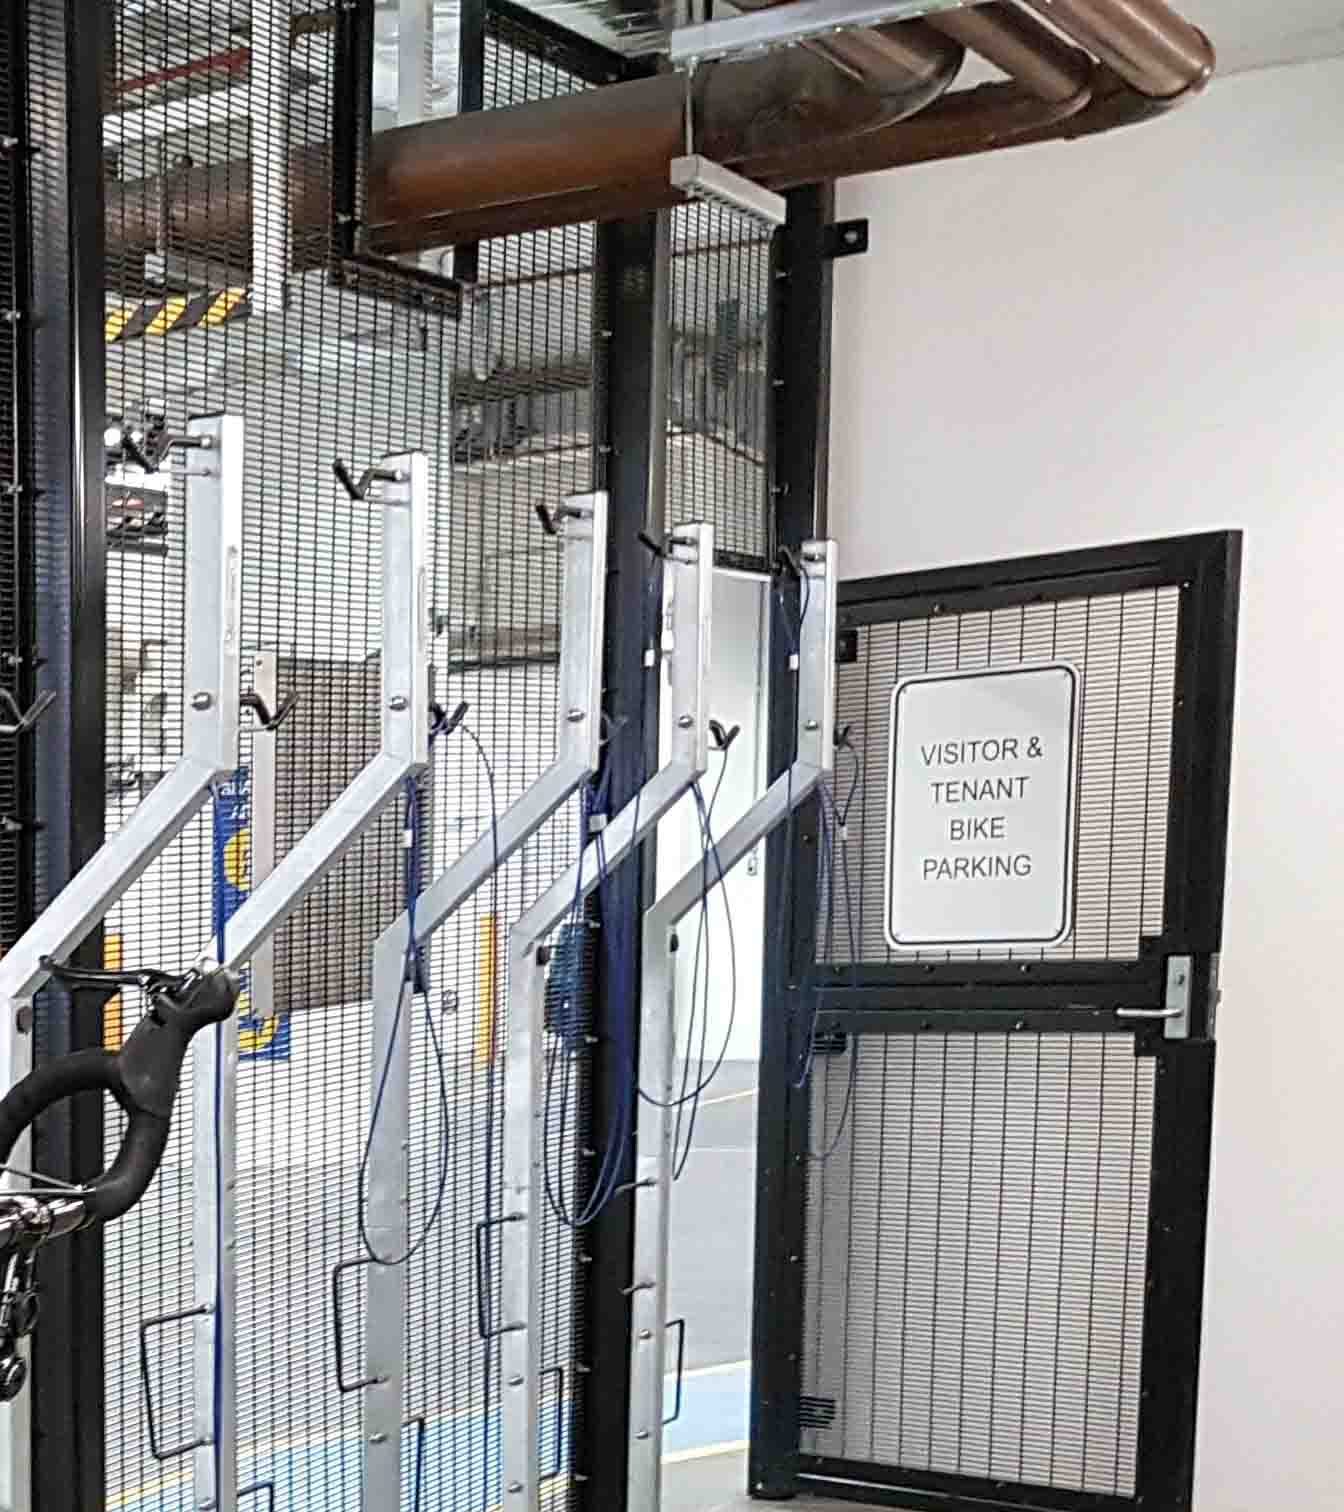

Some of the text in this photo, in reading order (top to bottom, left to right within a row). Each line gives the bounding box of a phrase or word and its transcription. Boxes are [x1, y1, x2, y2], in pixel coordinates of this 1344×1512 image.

[920, 736, 1044, 766] VISITOR &
[931, 776, 1030, 804] TENANT
[950, 816, 1006, 841] BIKE
[922, 854, 1032, 880] PARKING
